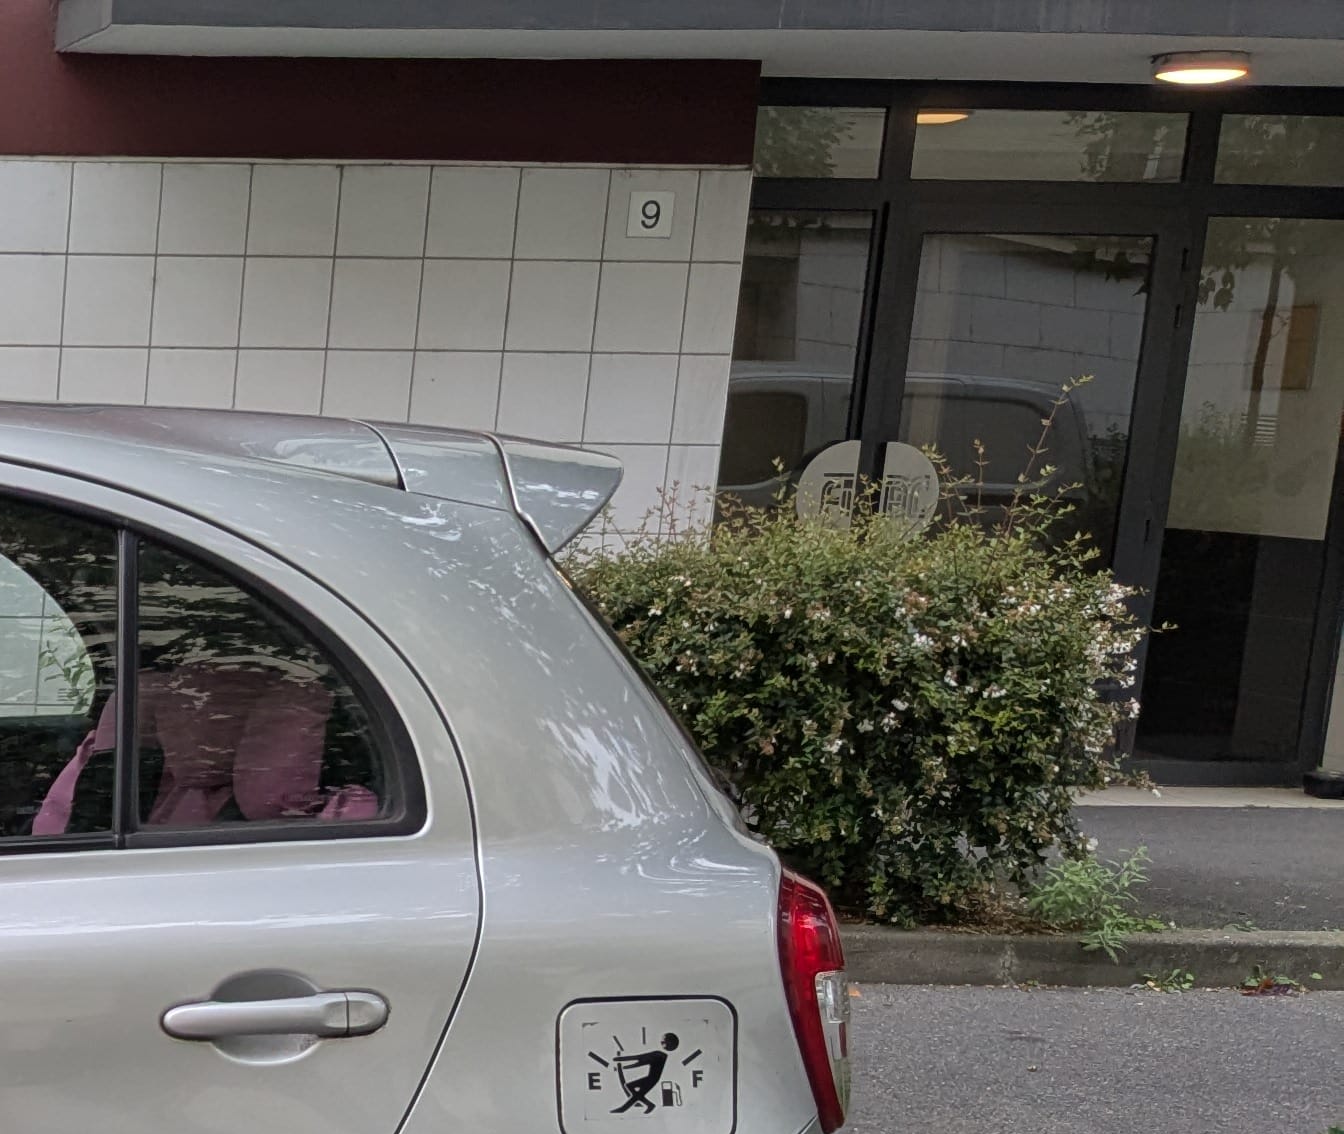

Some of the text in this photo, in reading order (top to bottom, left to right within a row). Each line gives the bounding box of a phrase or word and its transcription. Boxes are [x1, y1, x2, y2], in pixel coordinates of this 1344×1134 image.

[640, 199, 660, 229] 9
[588, 1072, 602, 1090] E
[692, 1070, 704, 1088] F
